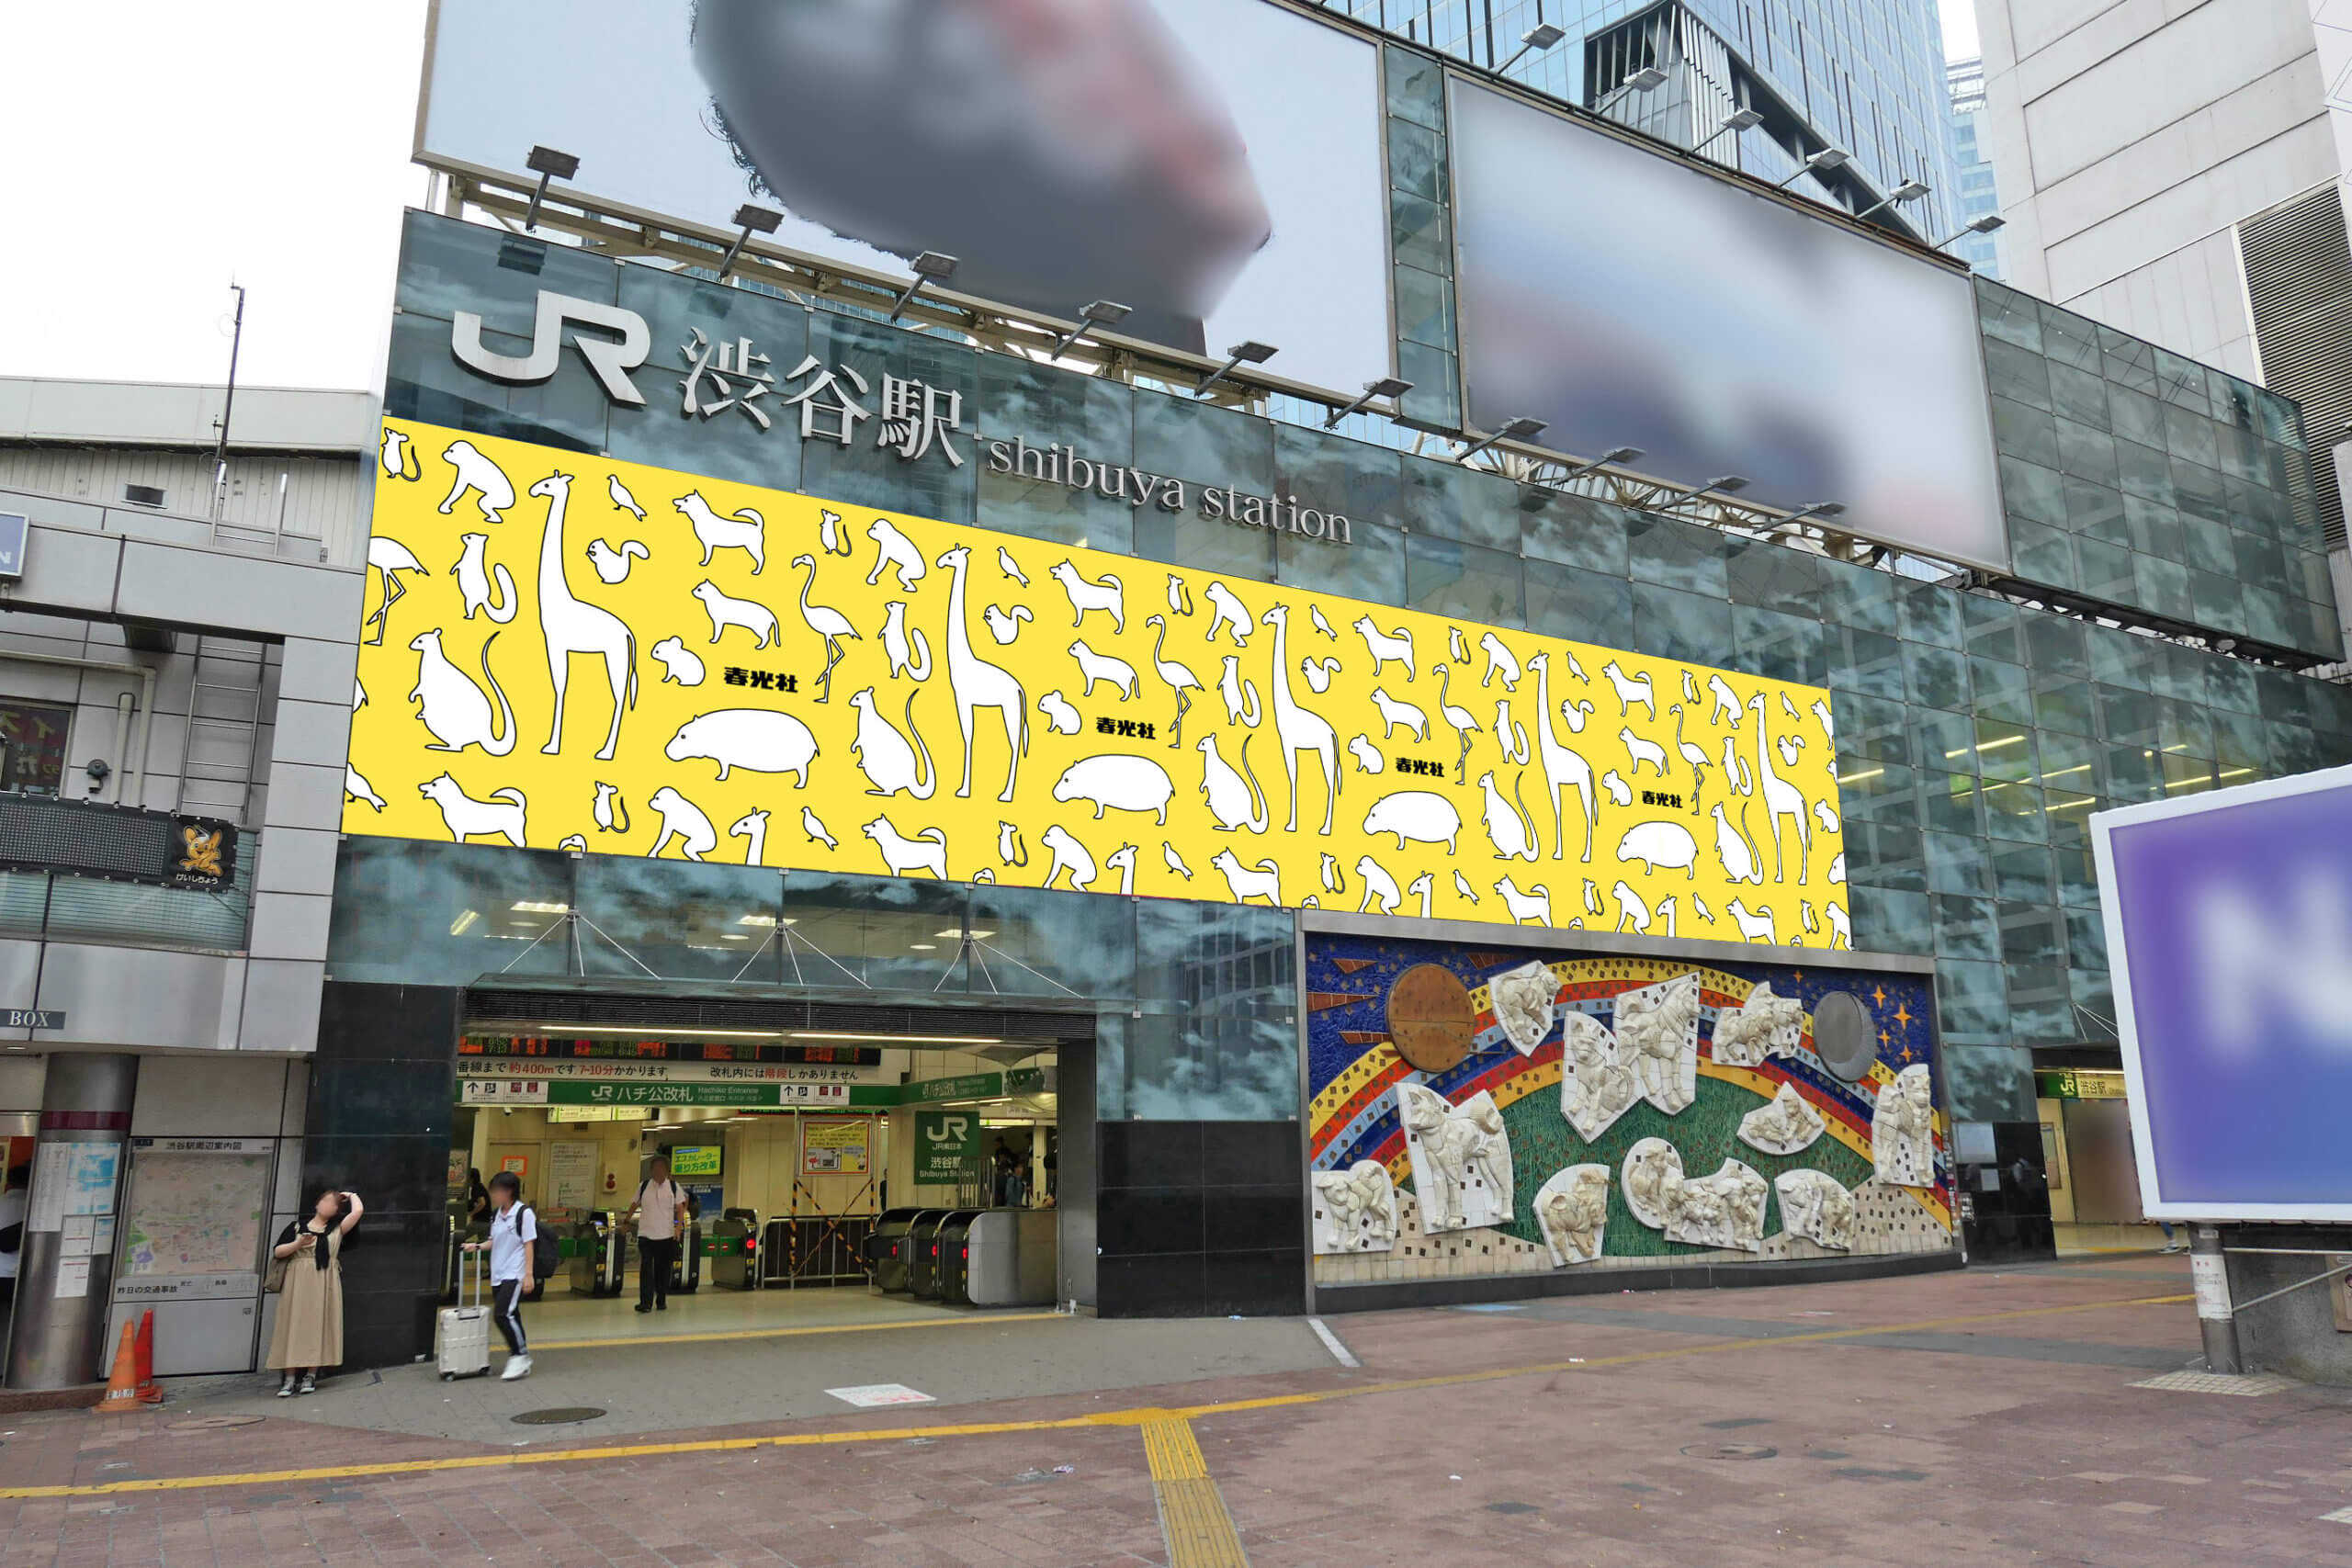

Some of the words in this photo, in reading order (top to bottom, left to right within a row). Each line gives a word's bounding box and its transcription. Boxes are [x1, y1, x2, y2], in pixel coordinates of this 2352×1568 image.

[451, 290, 650, 405] JR
[679, 326, 965, 468] 渋谷駅
[988, 435, 1187, 510] shibuya
[1204, 484, 1352, 545] station
[724, 668, 797, 693] 春光社
[1096, 716, 1156, 739] 春光社
[1396, 758, 1445, 777] 春光社
[1642, 790, 1684, 808] 春光社
[8, 1010, 50, 1027] BOX
[592, 1086, 613, 1098] JR
[616, 1087, 694, 1101] ハチ公改札
[2060, 1079, 2075, 1092] JR
[2080, 1081, 2107, 1094] 渋谷駅
[927, 1117, 967, 1141] JR
[920, 1170, 947, 1179] Shibuya
